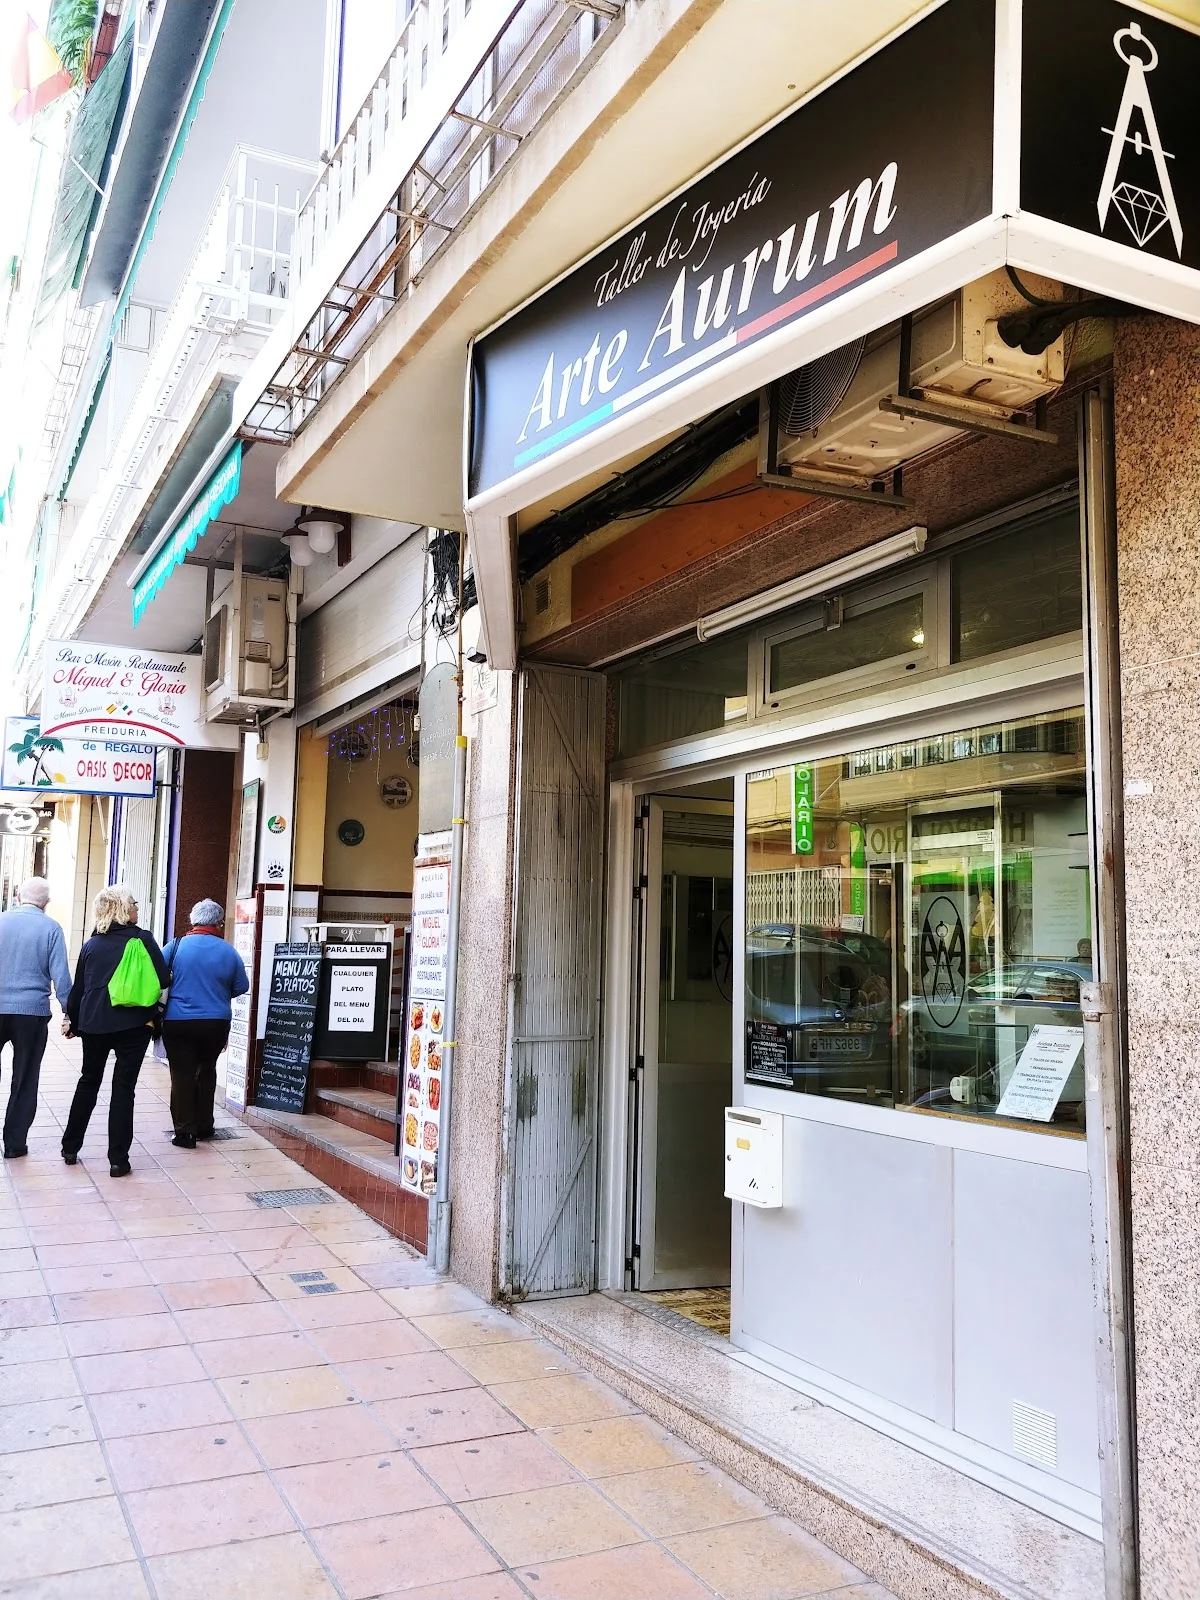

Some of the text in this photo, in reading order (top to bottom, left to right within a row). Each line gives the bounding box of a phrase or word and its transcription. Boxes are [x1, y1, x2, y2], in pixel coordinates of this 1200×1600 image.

[594, 172, 772, 307] Taller de Joyería
[516, 161, 898, 444] Arte Aurum
[55, 648, 187, 674] Bar Mesón Restaurante
[53, 665, 187, 697] Miguel & Gloria
[84, 725, 147, 737] FREIDURIA
[82, 741, 153, 754] de REGALO
[77, 760, 152, 782] OASIS DECOR
[422, 917, 441, 929] MIGUEL
[421, 938, 440, 949] GLORIA
[274, 958, 320, 977] MENÚ 10€
[275, 978, 315, 994] 3 PLATOS
